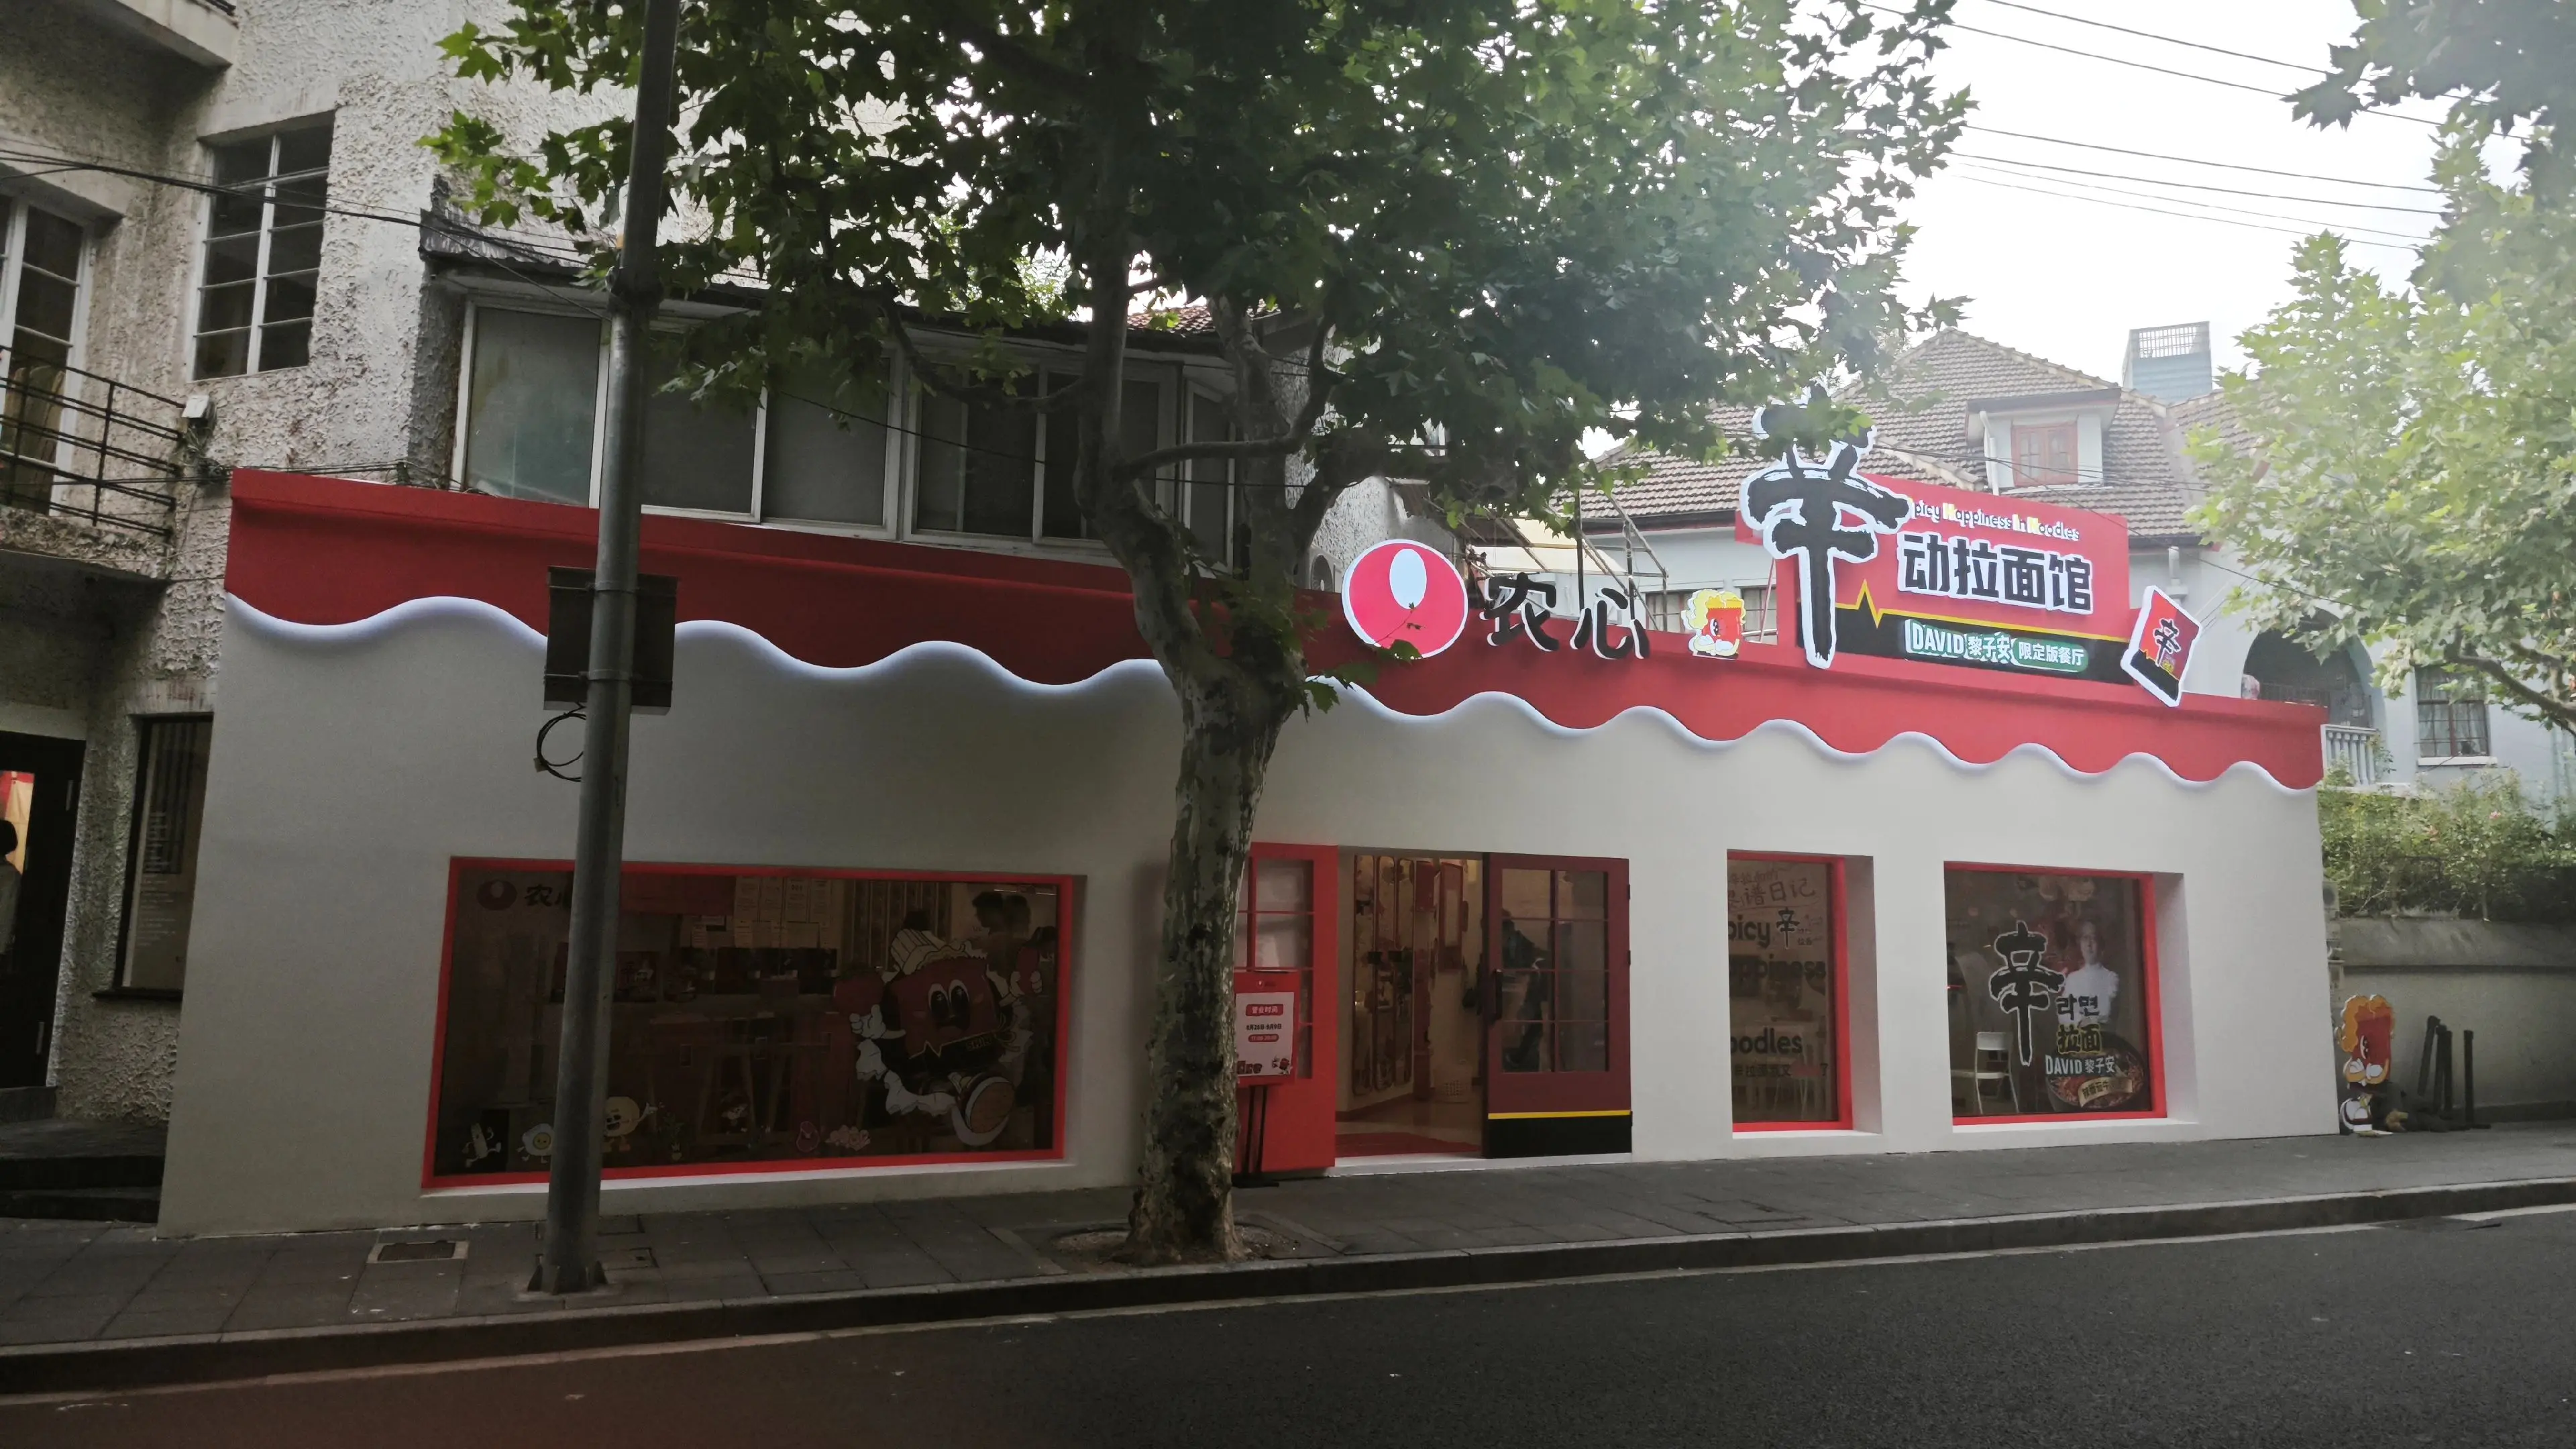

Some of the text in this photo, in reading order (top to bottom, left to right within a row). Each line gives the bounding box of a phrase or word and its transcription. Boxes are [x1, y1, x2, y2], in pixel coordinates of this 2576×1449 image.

[1911, 500, 1941, 523] picy
[1943, 502, 2012, 529] Happiness
[2027, 517, 2080, 541] Noodles
[1902, 533, 2091, 611] 动拉面馆
[1479, 572, 1650, 659] 农心
[1911, 621, 2084, 666] DAVID 黎子安 限定版餐厅
[2153, 618, 2182, 667] 辛
[1776, 906, 1801, 950] 辛
[1988, 920, 2065, 1067] 辛
[2055, 994, 2100, 1020] 라면
[2057, 1023, 2102, 1055] 拉面
[2045, 1054, 2116, 1075] DAVID 黎子安
